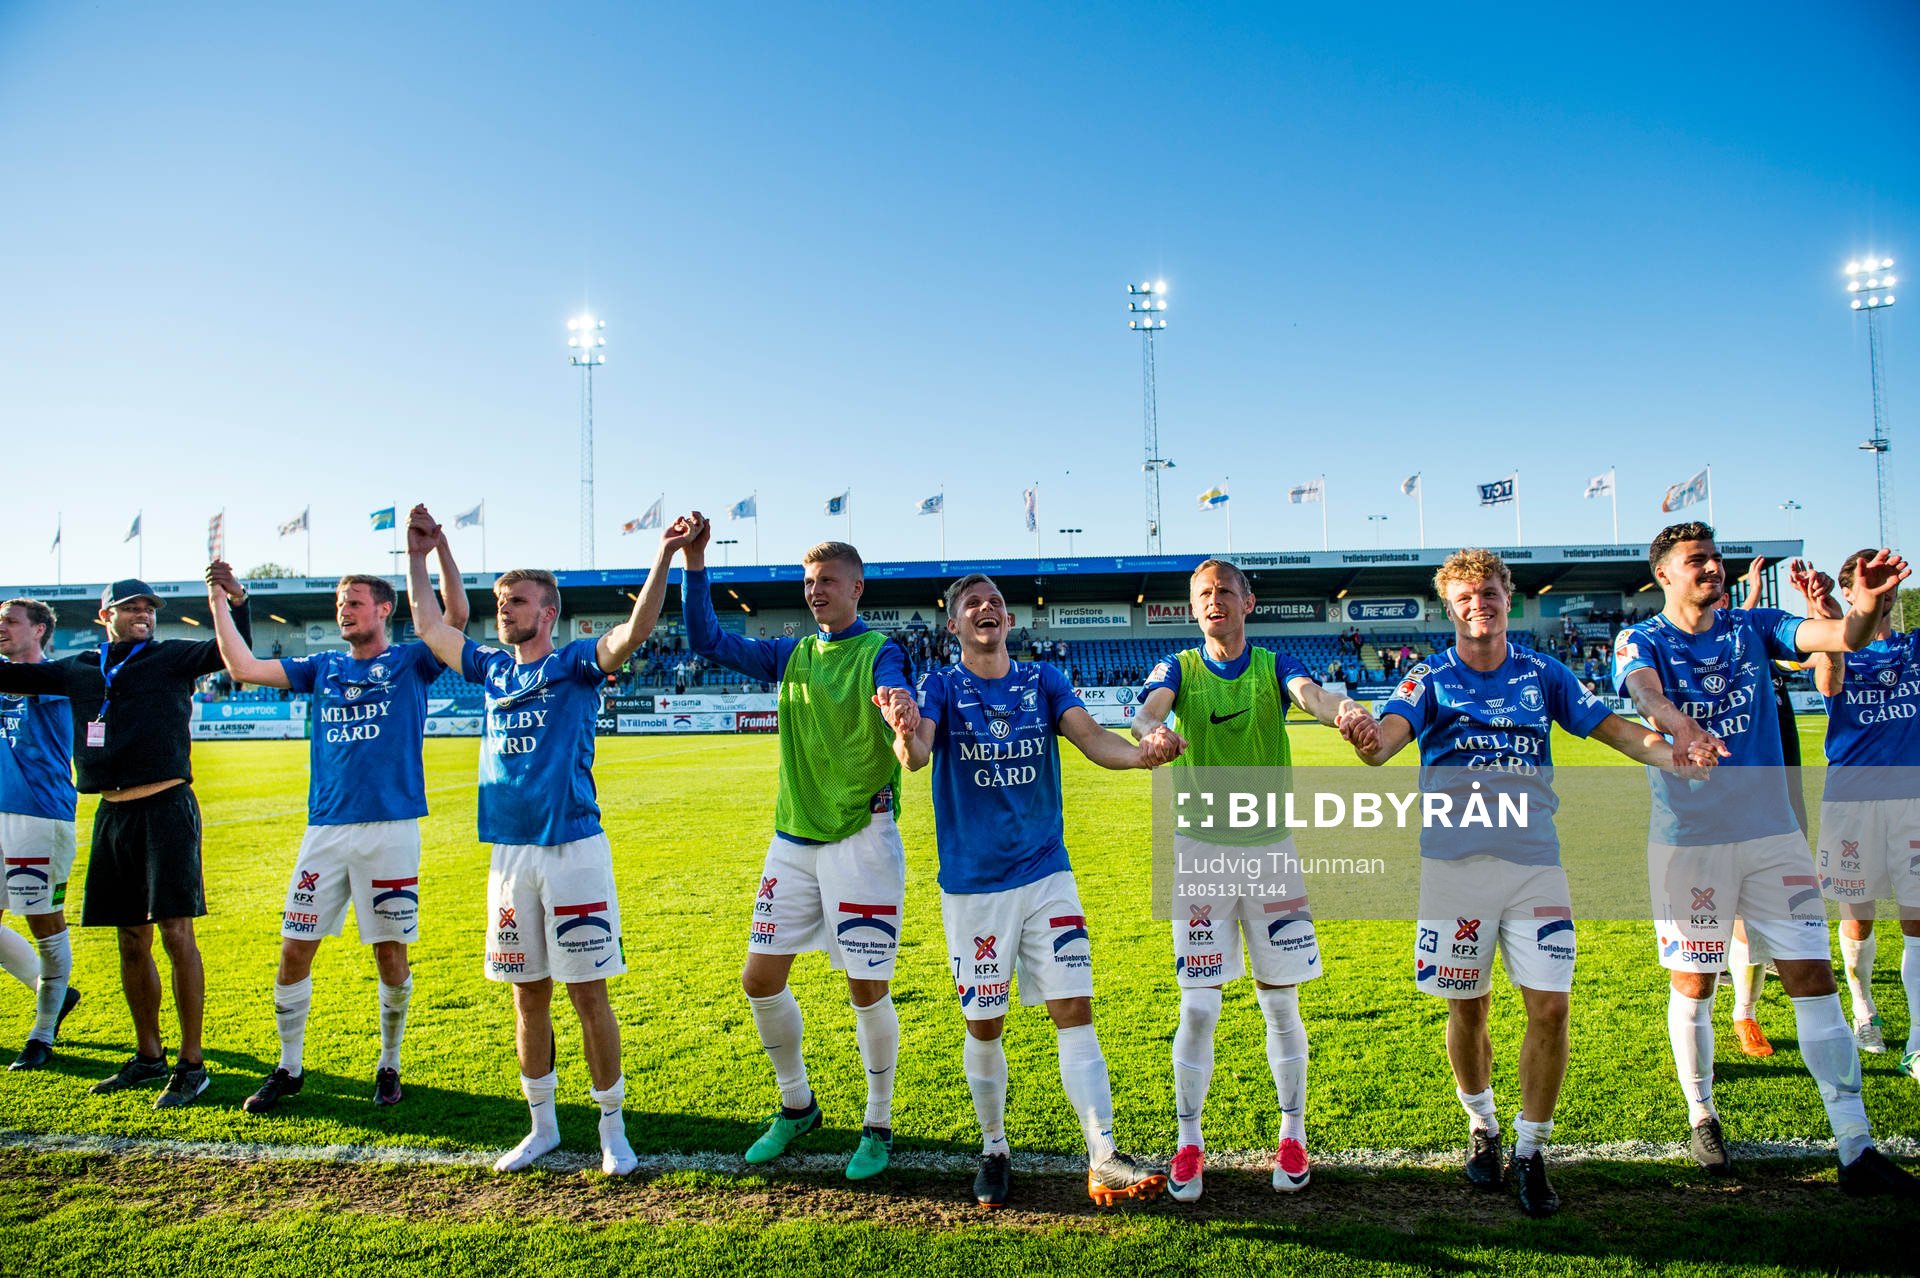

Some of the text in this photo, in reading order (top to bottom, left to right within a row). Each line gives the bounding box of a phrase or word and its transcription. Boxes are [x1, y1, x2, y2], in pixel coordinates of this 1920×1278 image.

[1241, 555, 1311, 566] Trelleborgs Allehanda
[1343, 553, 1419, 563] trelleborgsallehanda.se
[1059, 607, 1103, 616] FordStore
[1255, 604, 1314, 615] OPTIMERA
[862, 610, 899, 621] SAWI
[1060, 616, 1127, 625] HEDBERGS BIL
[1085, 690, 1105, 698] KFX
[615, 699, 652, 707] exakta
[672, 699, 701, 708] sigma
[320, 700, 392, 723] MELLBY
[1859, 703, 1917, 724] GÅRD
[493, 709, 549, 731] LLBY
[626, 718, 667, 727] Tillmobil
[1706, 714, 1750, 739] ÅRD
[326, 723, 380, 743] GÅRD
[960, 736, 1046, 761] MELLBY
[1467, 751, 1538, 777] GÅRD
[974, 763, 1037, 788] GÅRD
[1821, 850, 1829, 867] 3
[1840, 860, 1860, 869] KFX
[1832, 877, 1865, 888] INTER
[1833, 886, 1866, 897] SPORT
[293, 892, 315, 903] KFX
[286, 911, 318, 923] INTER
[1691, 914, 1718, 925] KFX
[284, 921, 317, 933] SPORT
[498, 932, 519, 941] KFX
[589, 937, 605, 945] Hamn
[750, 932, 774, 945] PORT
[1189, 930, 1214, 941] KFX
[1419, 927, 1439, 953] 23
[837, 938, 869, 948] Trelleborgs
[870, 940, 888, 949] Hamn
[1270, 937, 1303, 948] Trelleborgs
[1681, 940, 1724, 952] INTER
[1452, 943, 1478, 956] KFX
[1537, 943, 1571, 954] Trelleborgs
[492, 952, 525, 962] INTER
[1054, 953, 1087, 963] Trelleborgs
[1186, 953, 1222, 967] INTER
[1682, 952, 1725, 963] SPORT
[492, 962, 525, 973] SPORT
[954, 957, 961, 979] 7
[974, 963, 999, 975] KFX
[1187, 964, 1223, 978] SPORT
[1438, 965, 1479, 979] INTER
[978, 980, 1009, 995] INTER
[1437, 978, 1479, 990] SPORT
